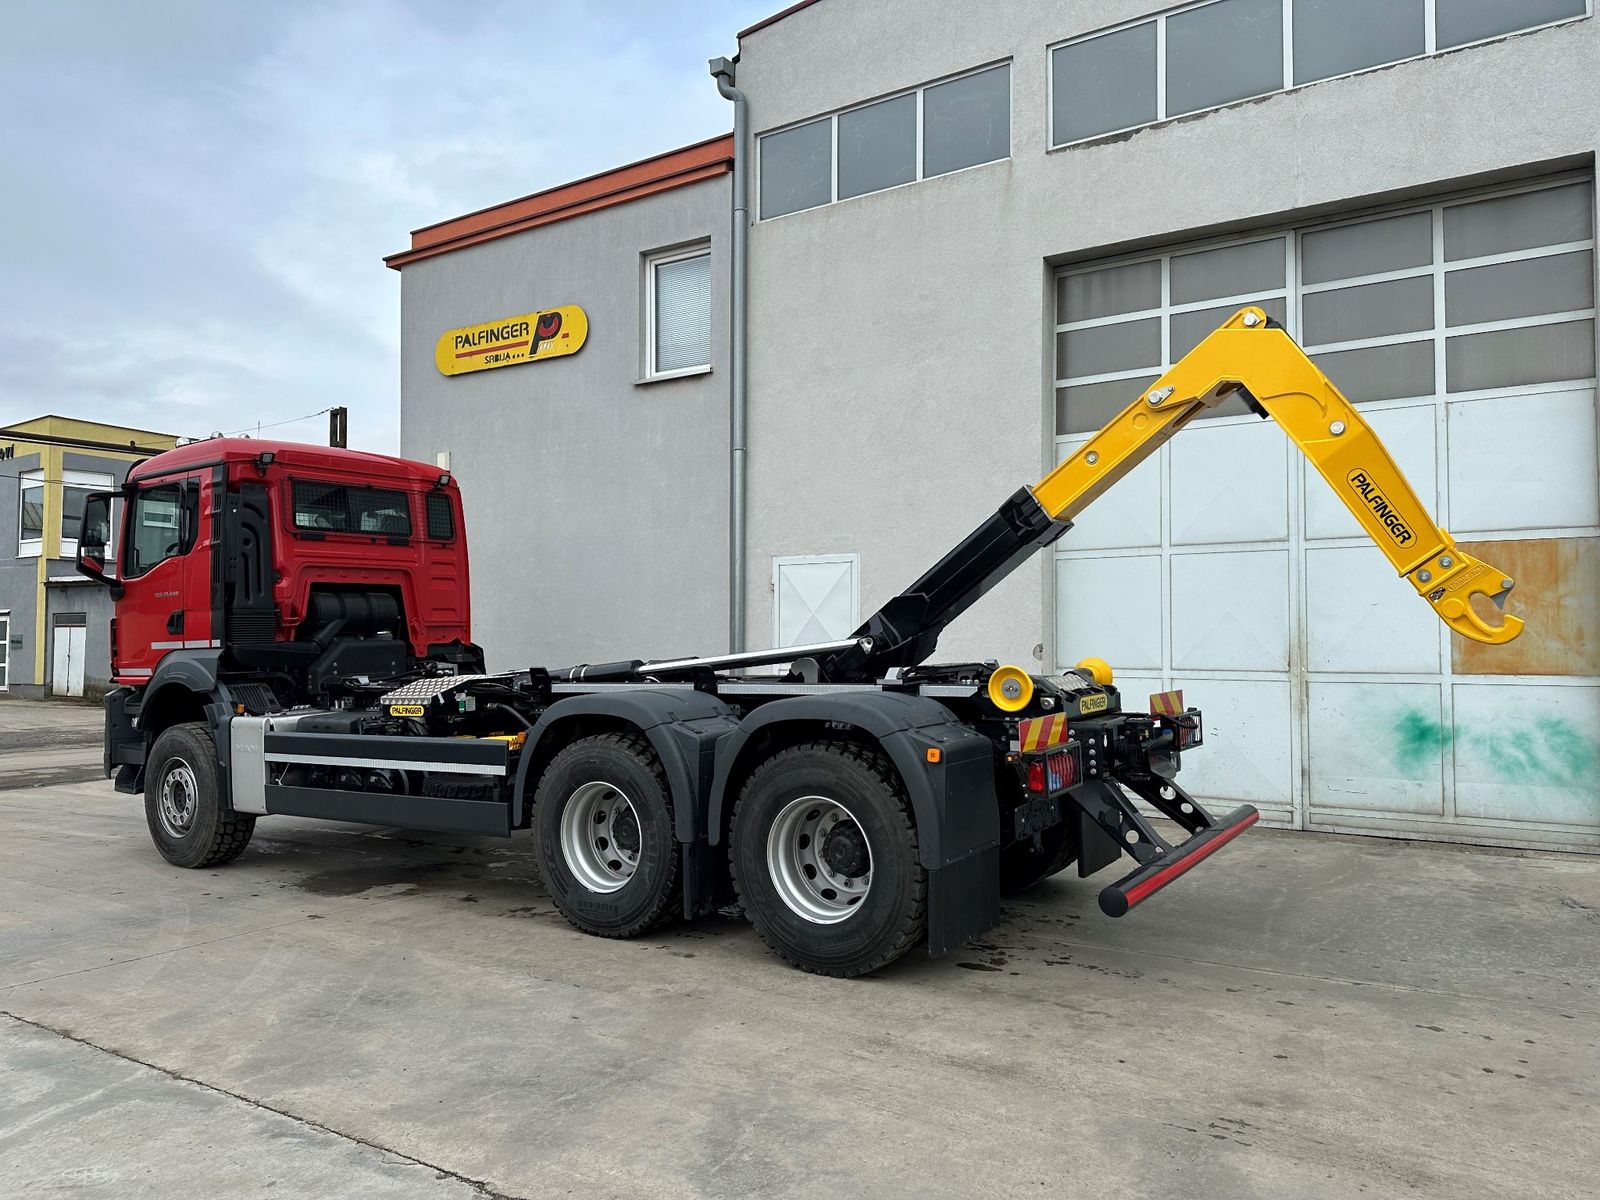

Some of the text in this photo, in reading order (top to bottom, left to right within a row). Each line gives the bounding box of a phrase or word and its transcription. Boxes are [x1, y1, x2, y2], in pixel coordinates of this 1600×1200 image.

[455, 321, 530, 350] PALFINGER
[1350, 472, 1412, 545] PALFINGER
[391, 706, 422, 715] PALFINGER
